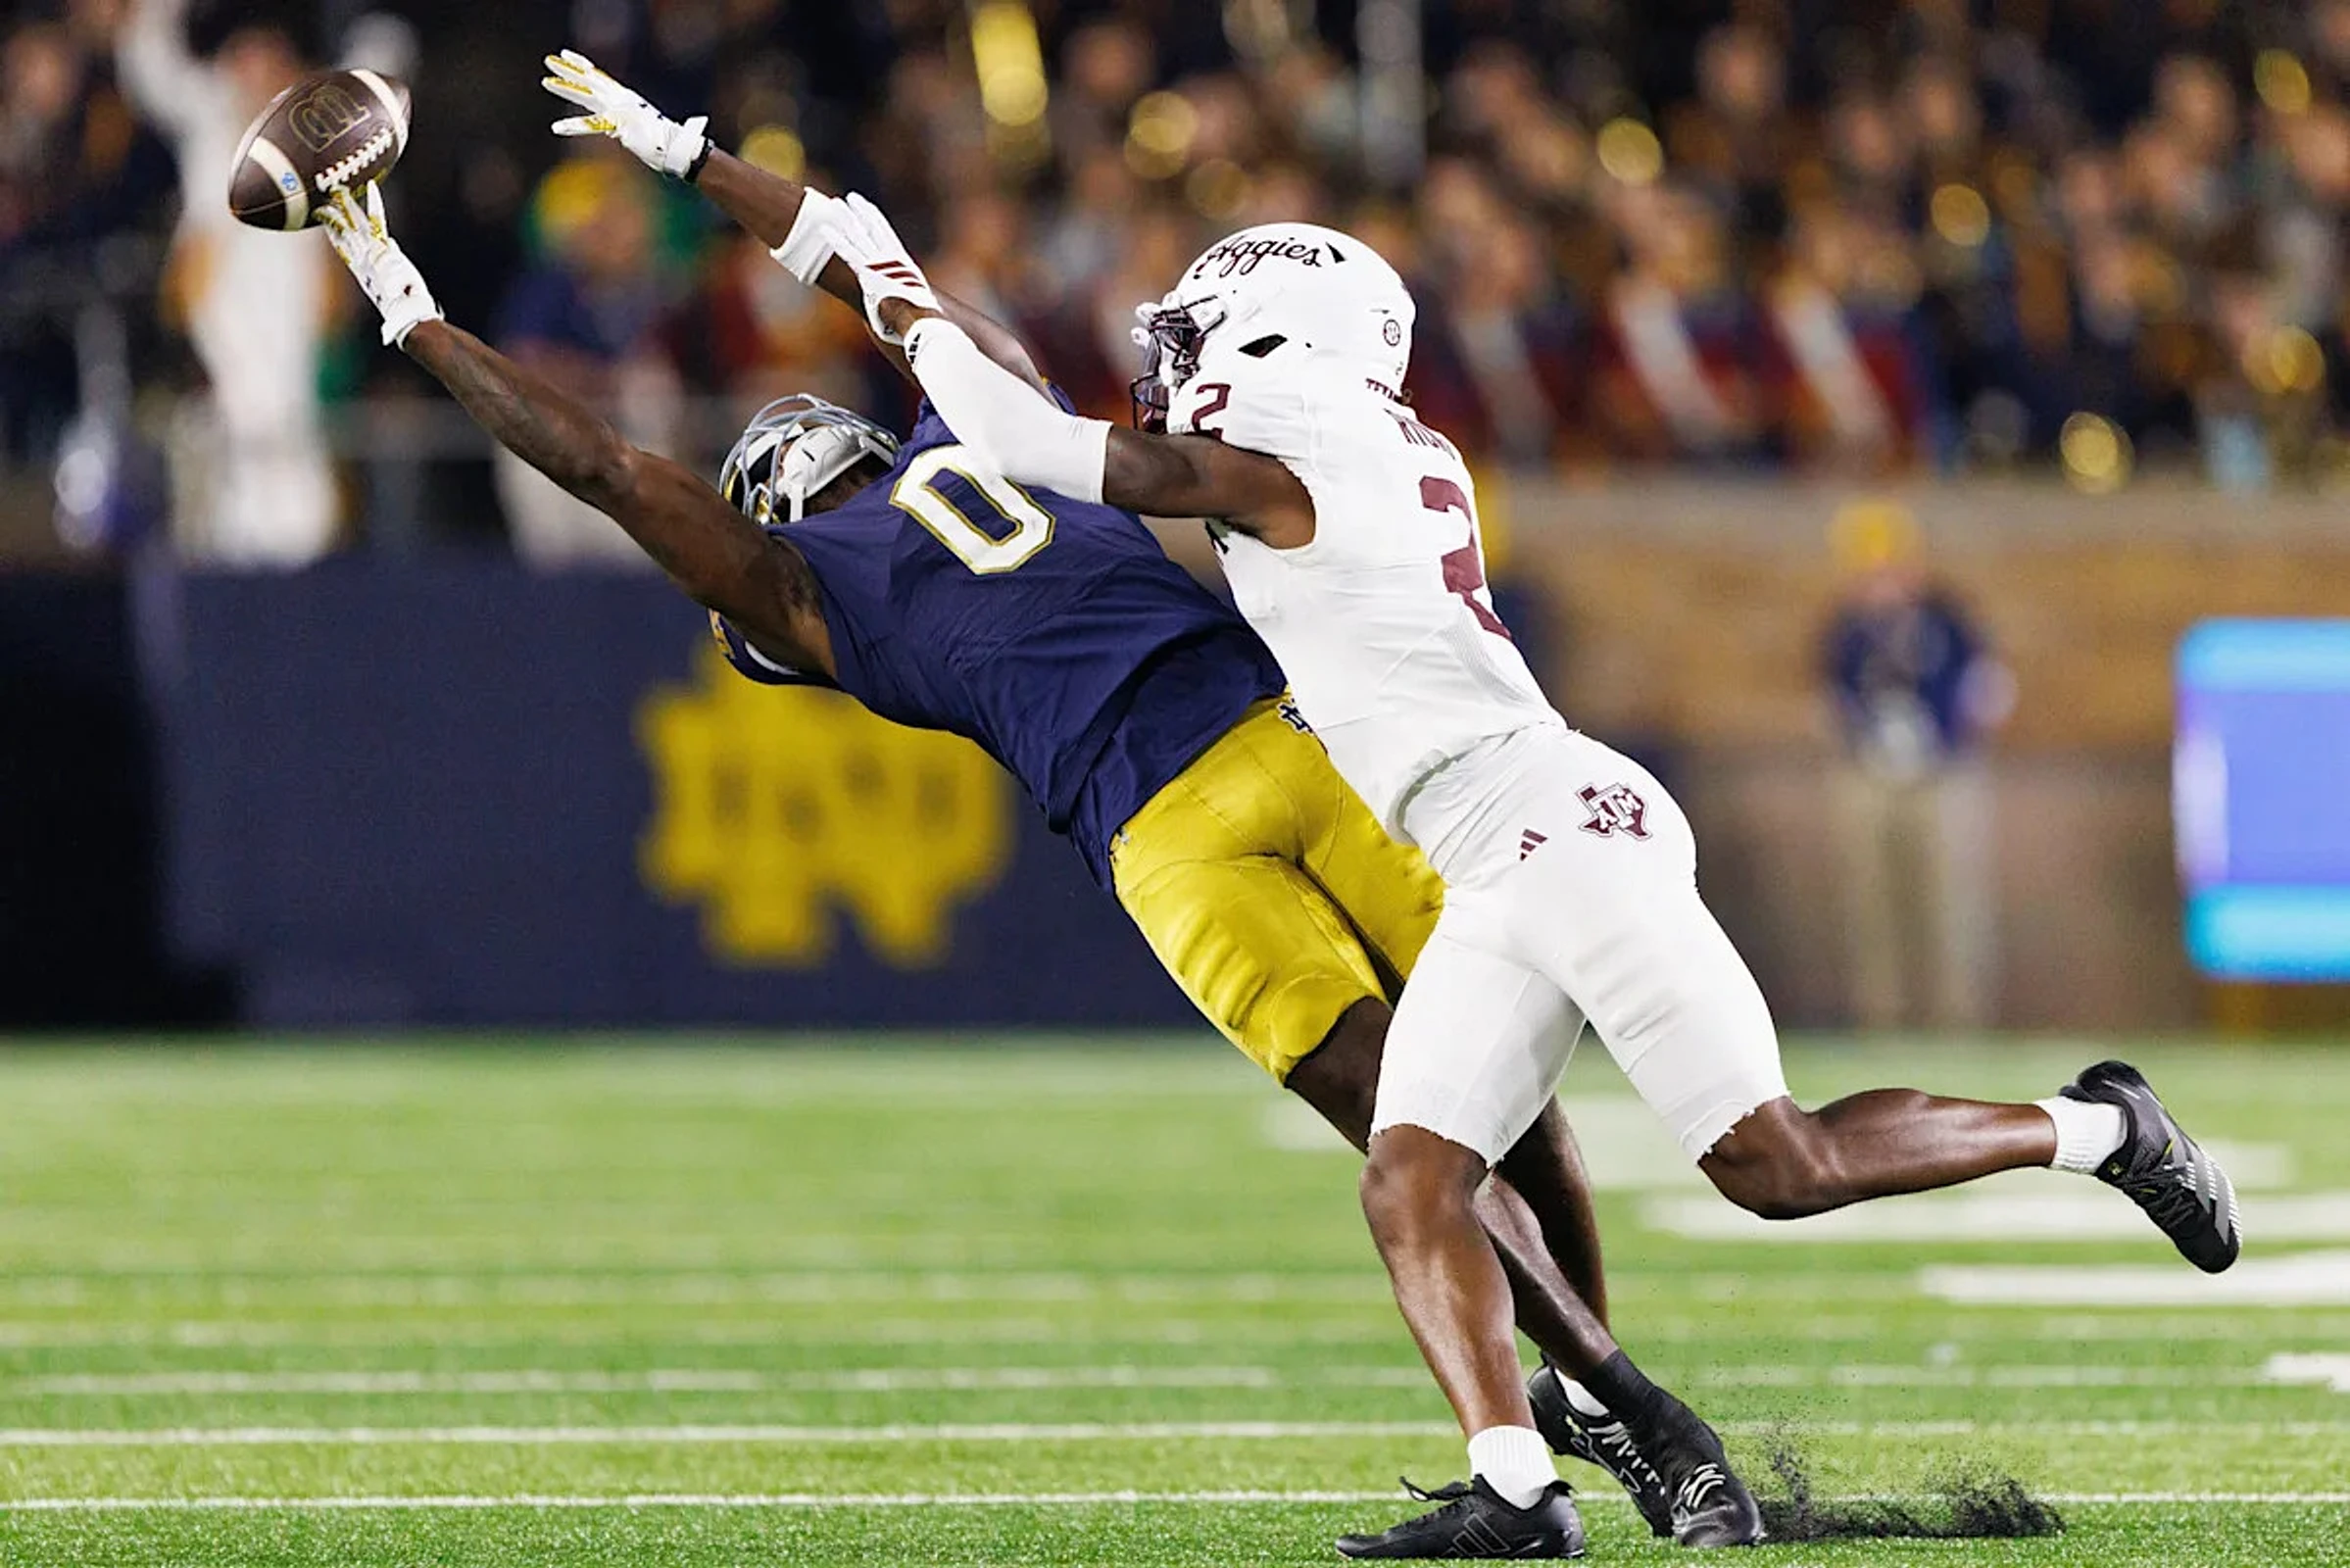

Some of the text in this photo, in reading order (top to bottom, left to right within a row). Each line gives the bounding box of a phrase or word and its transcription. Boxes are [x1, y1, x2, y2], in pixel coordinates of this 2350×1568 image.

[1194, 234, 1322, 278] Aggies
[1191, 382, 1232, 441] 2
[889, 443, 1056, 575] 0
[1419, 475, 1512, 640] 2
